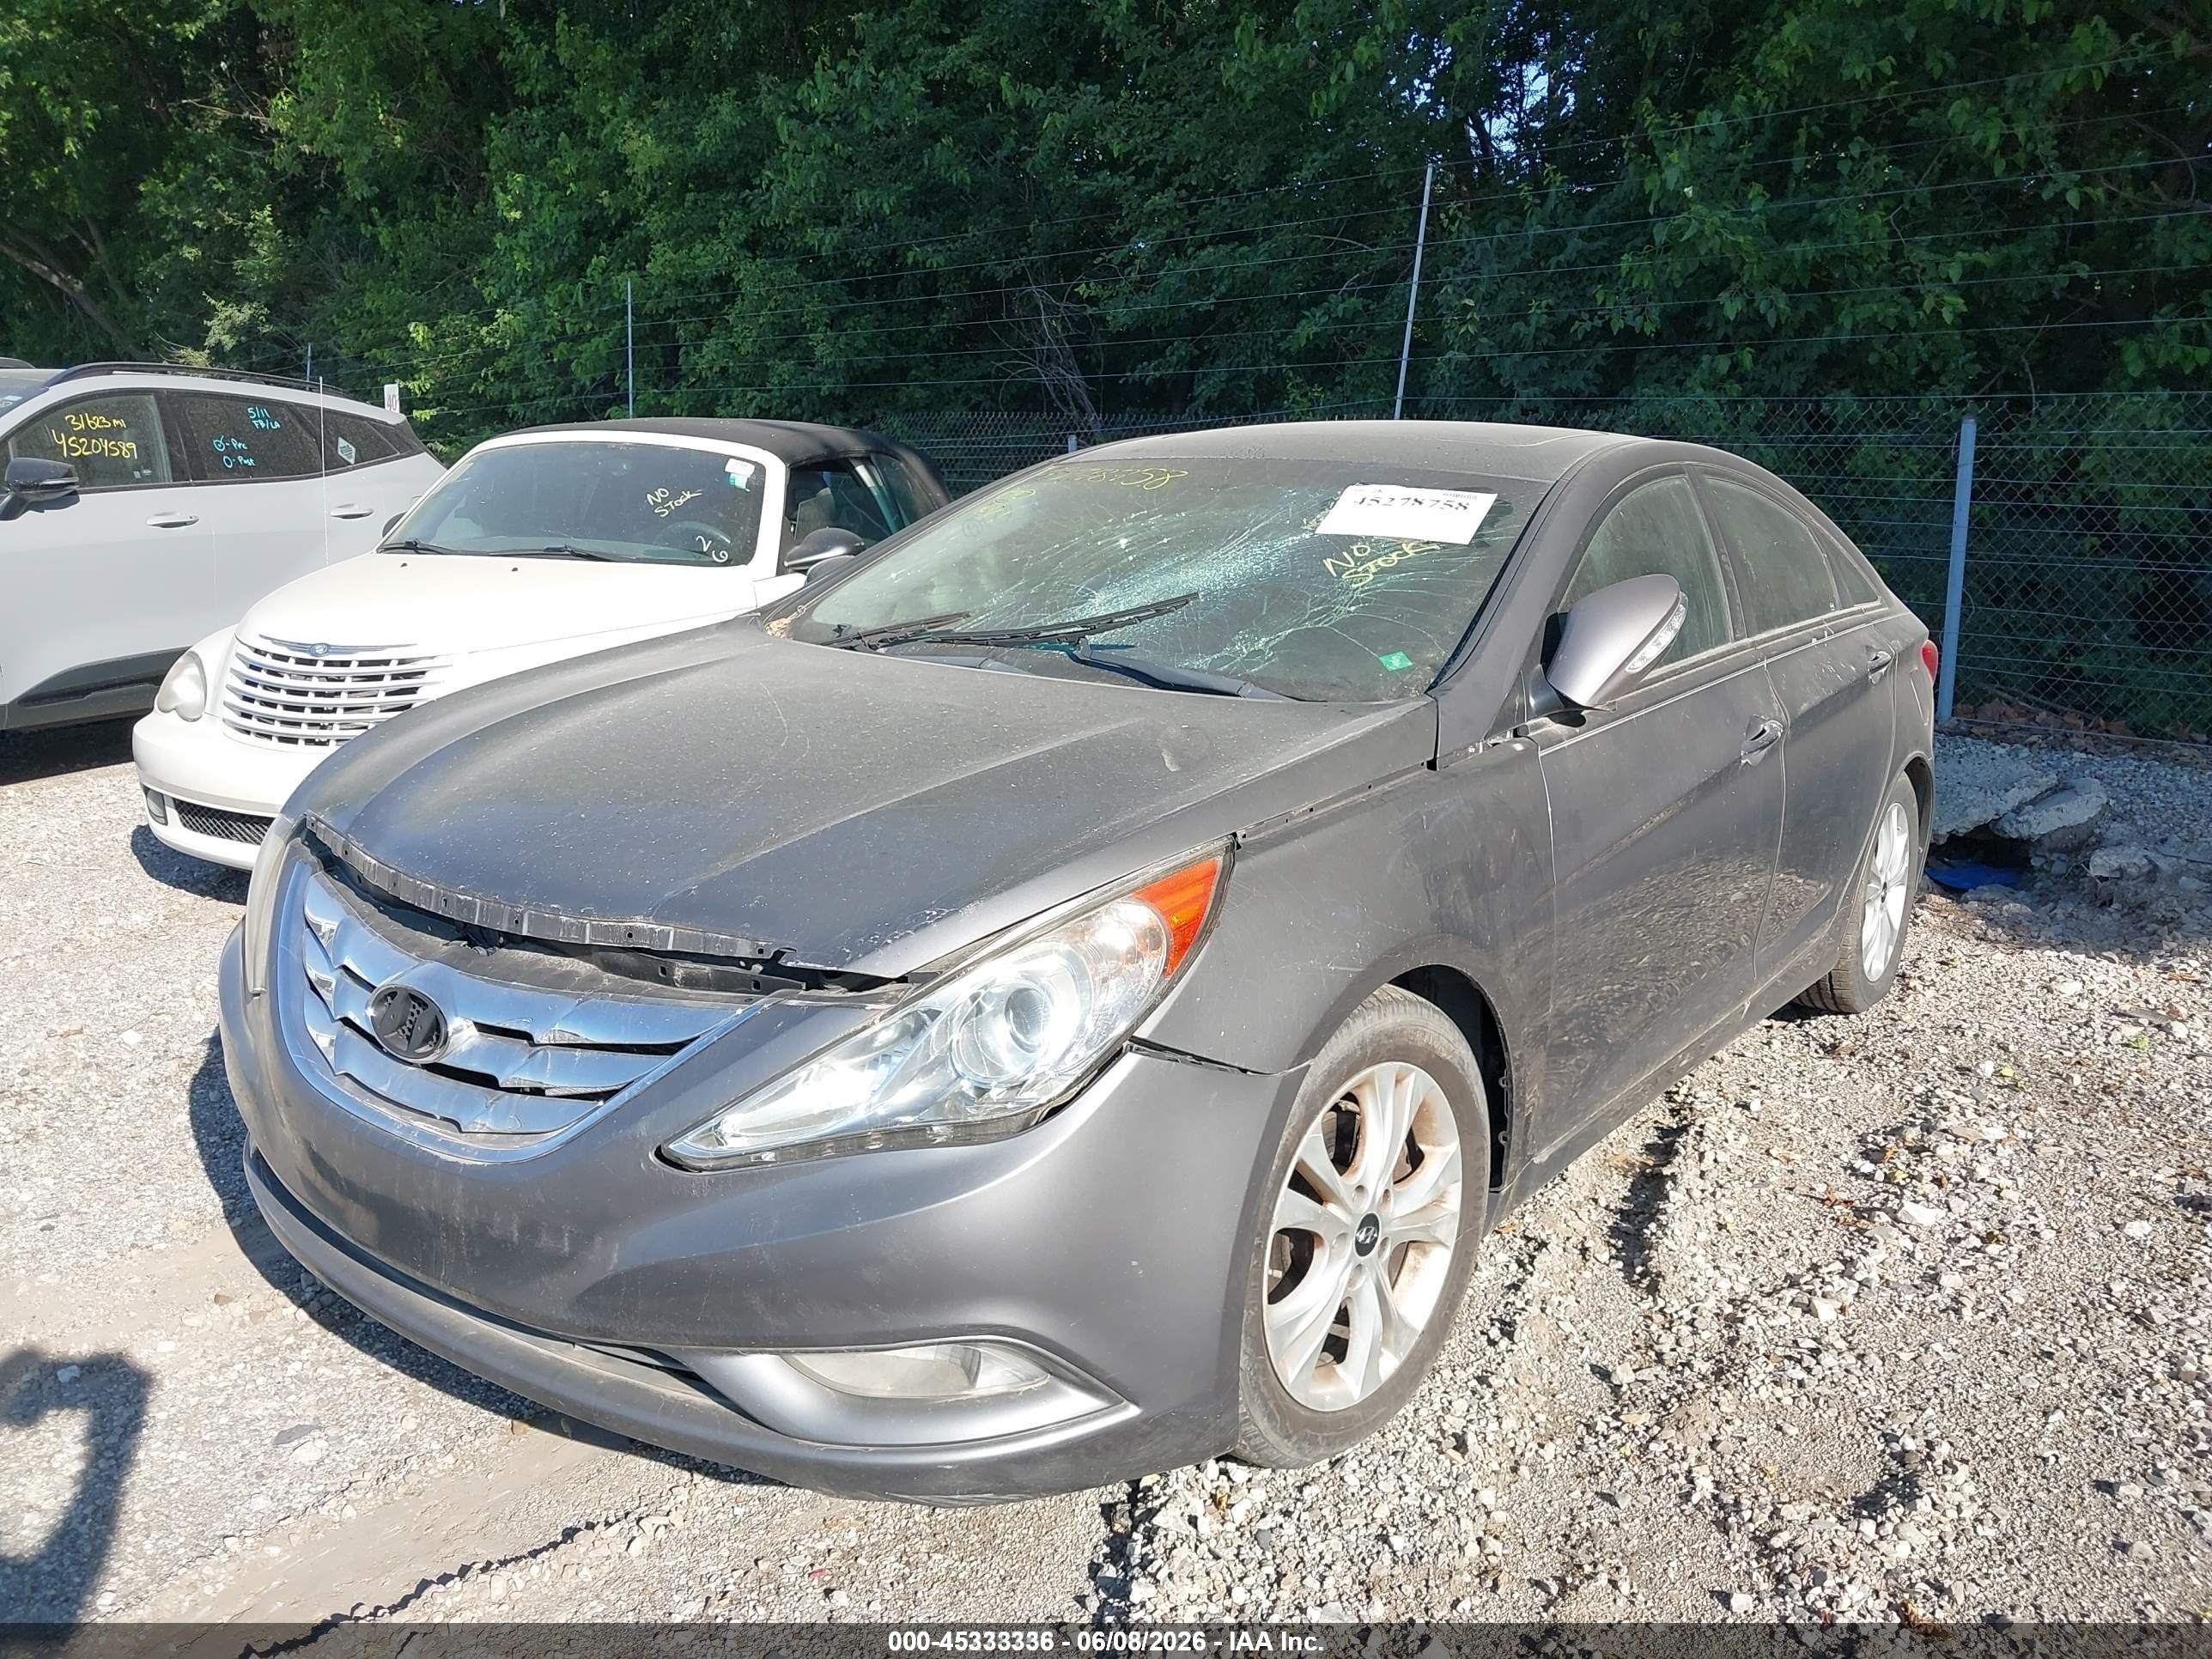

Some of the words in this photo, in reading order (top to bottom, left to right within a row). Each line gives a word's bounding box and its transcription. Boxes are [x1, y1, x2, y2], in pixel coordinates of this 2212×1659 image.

[64, 412, 112, 430] 31623
[52, 428, 137, 459] 45204589
[646, 488, 670, 506] NO
